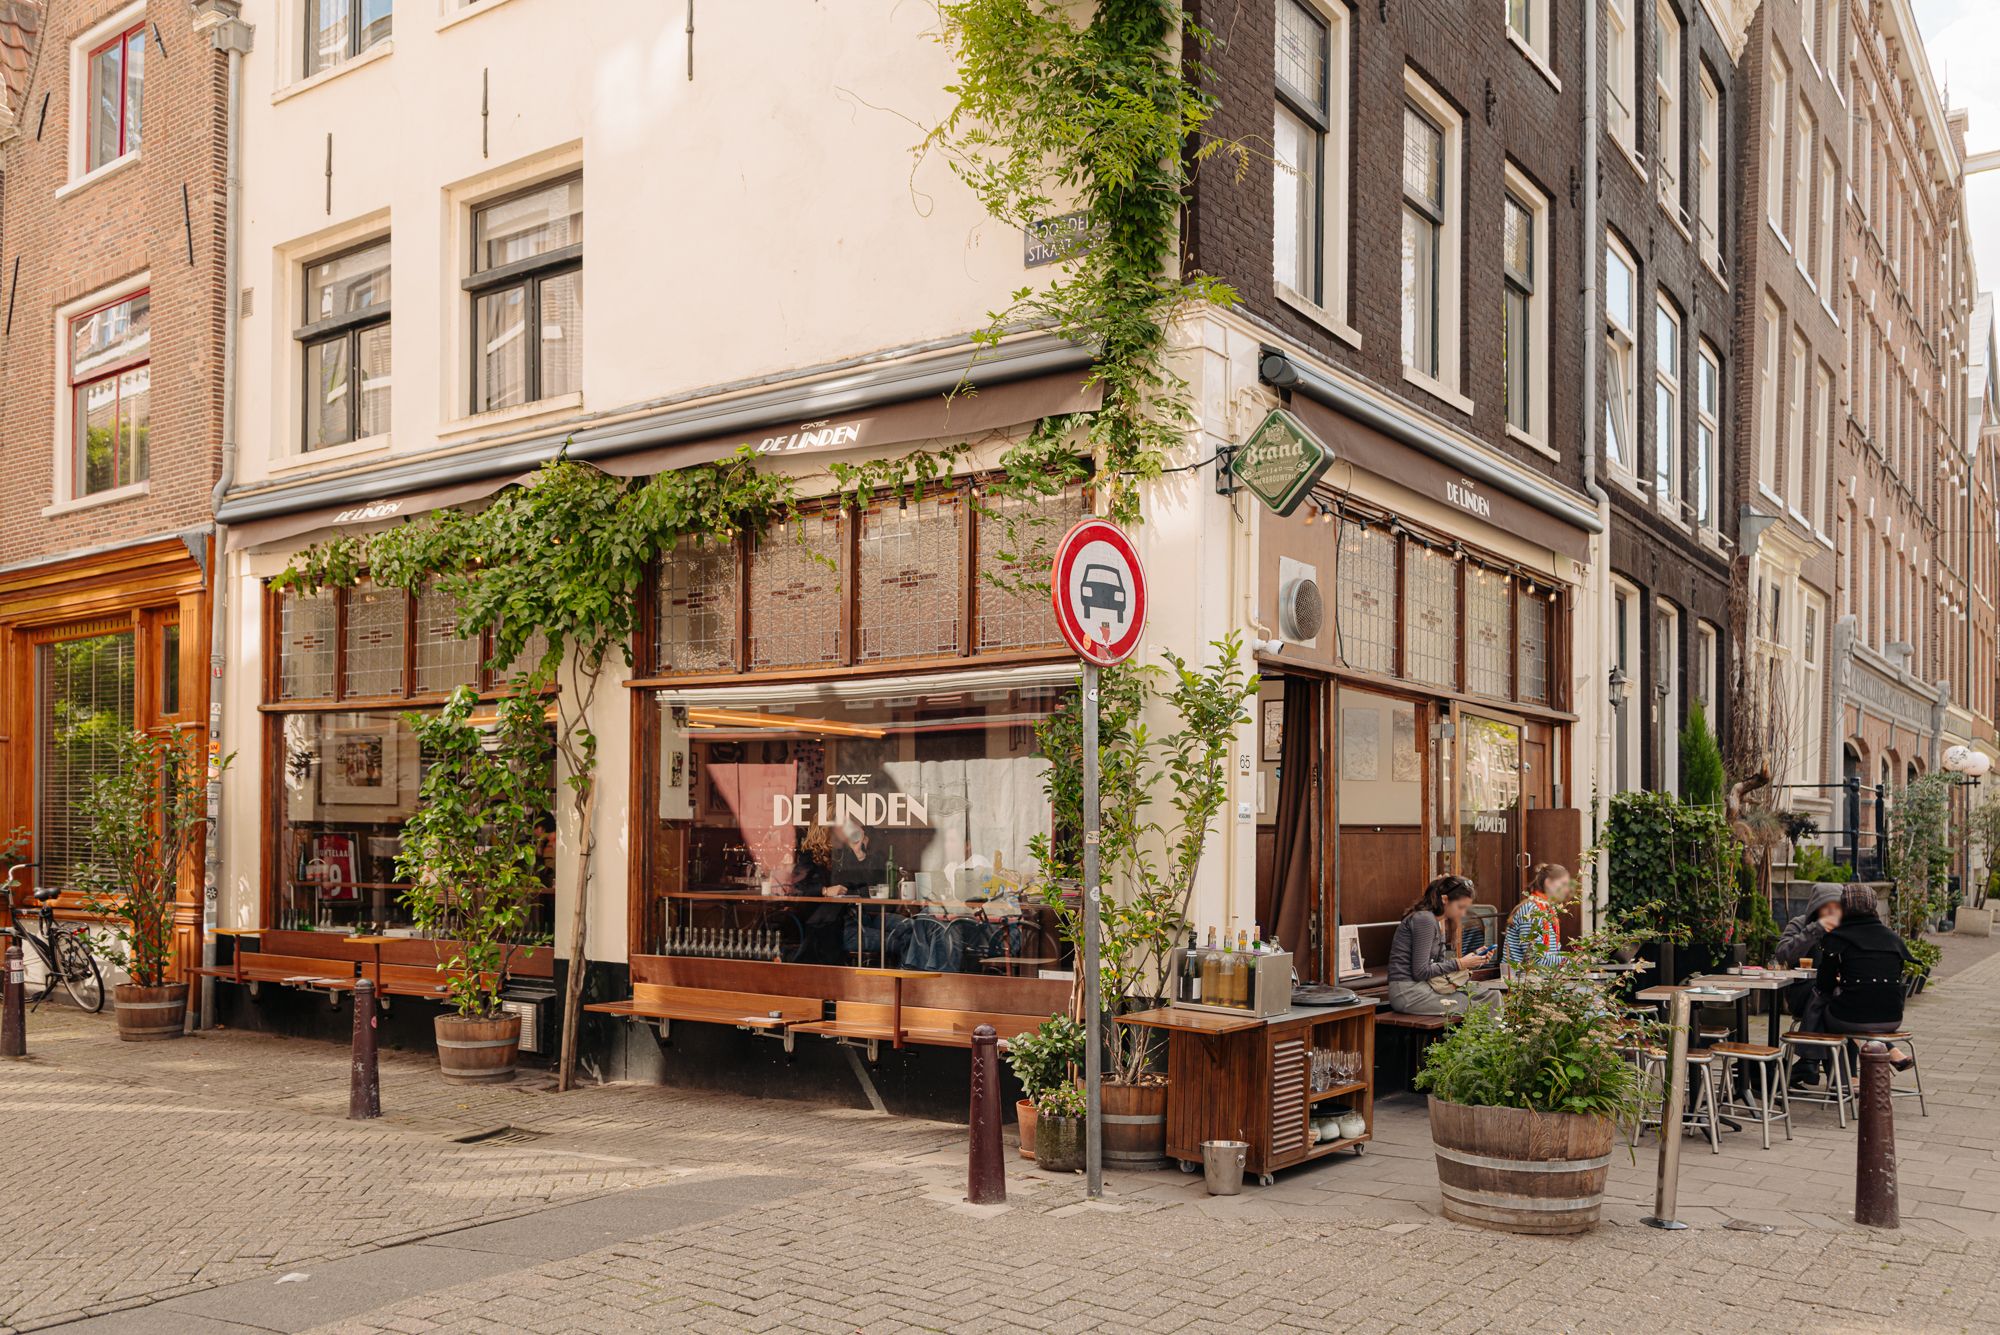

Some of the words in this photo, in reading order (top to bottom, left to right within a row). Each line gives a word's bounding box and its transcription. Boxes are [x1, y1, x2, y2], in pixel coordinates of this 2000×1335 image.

[756, 436, 788, 452] DE
[786, 424, 861, 450] LINDEN
[1245, 438, 1304, 465] Brand
[1446, 480, 1460, 505] DE
[1460, 487, 1490, 517] LINDEN
[1240, 754, 1251, 769] 65
[826, 774, 872, 785] CAFE
[773, 794, 811, 826] DE
[818, 792, 928, 826] LINDEN
[329, 864, 342, 897] 9
